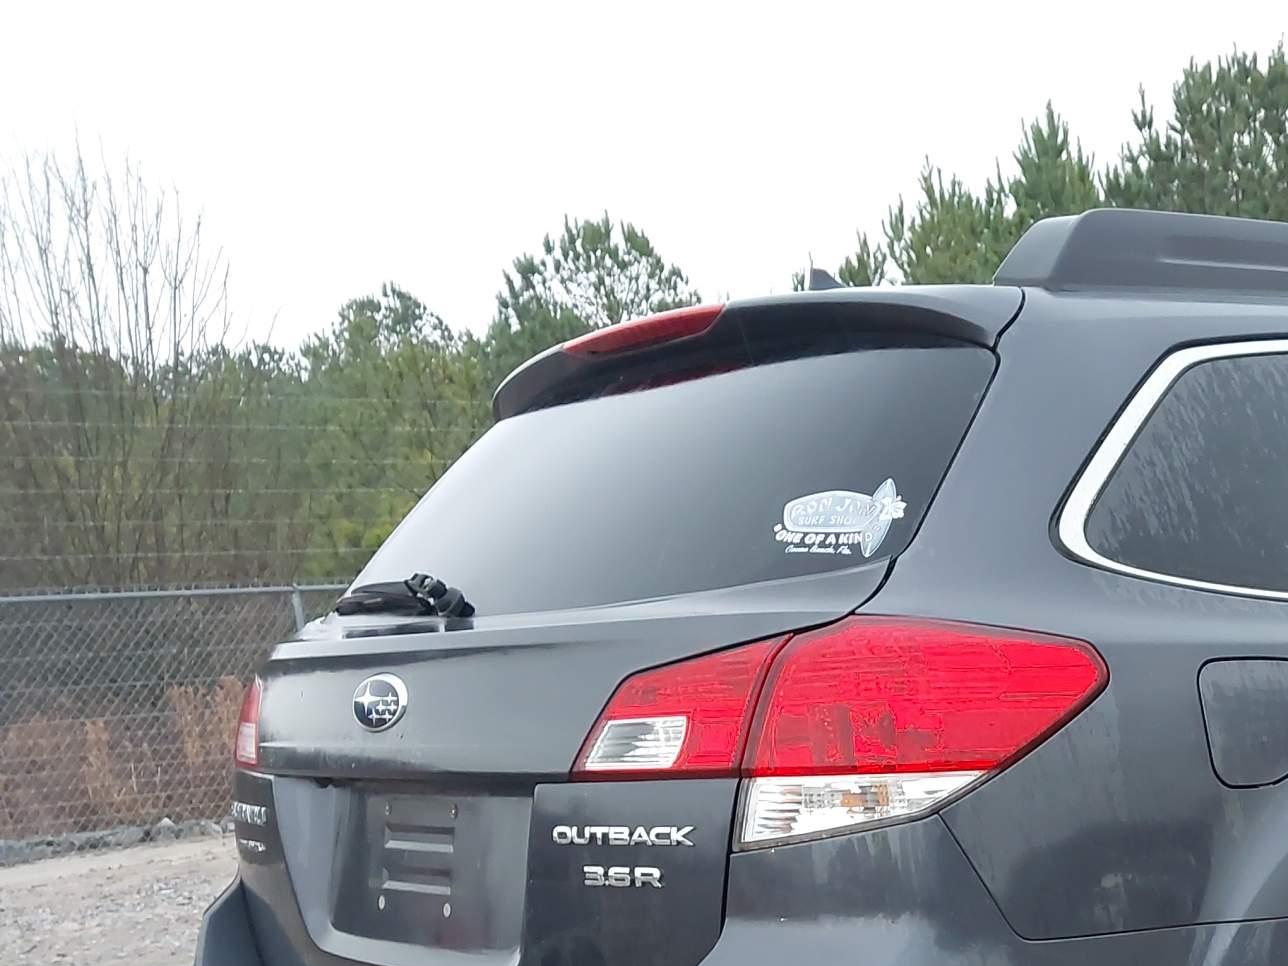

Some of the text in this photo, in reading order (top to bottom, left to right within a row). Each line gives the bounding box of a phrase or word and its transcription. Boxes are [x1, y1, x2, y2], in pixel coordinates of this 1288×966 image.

[804, 533, 826, 545] OF
[825, 533, 837, 545] A
[553, 825, 695, 846] OUTBACK
